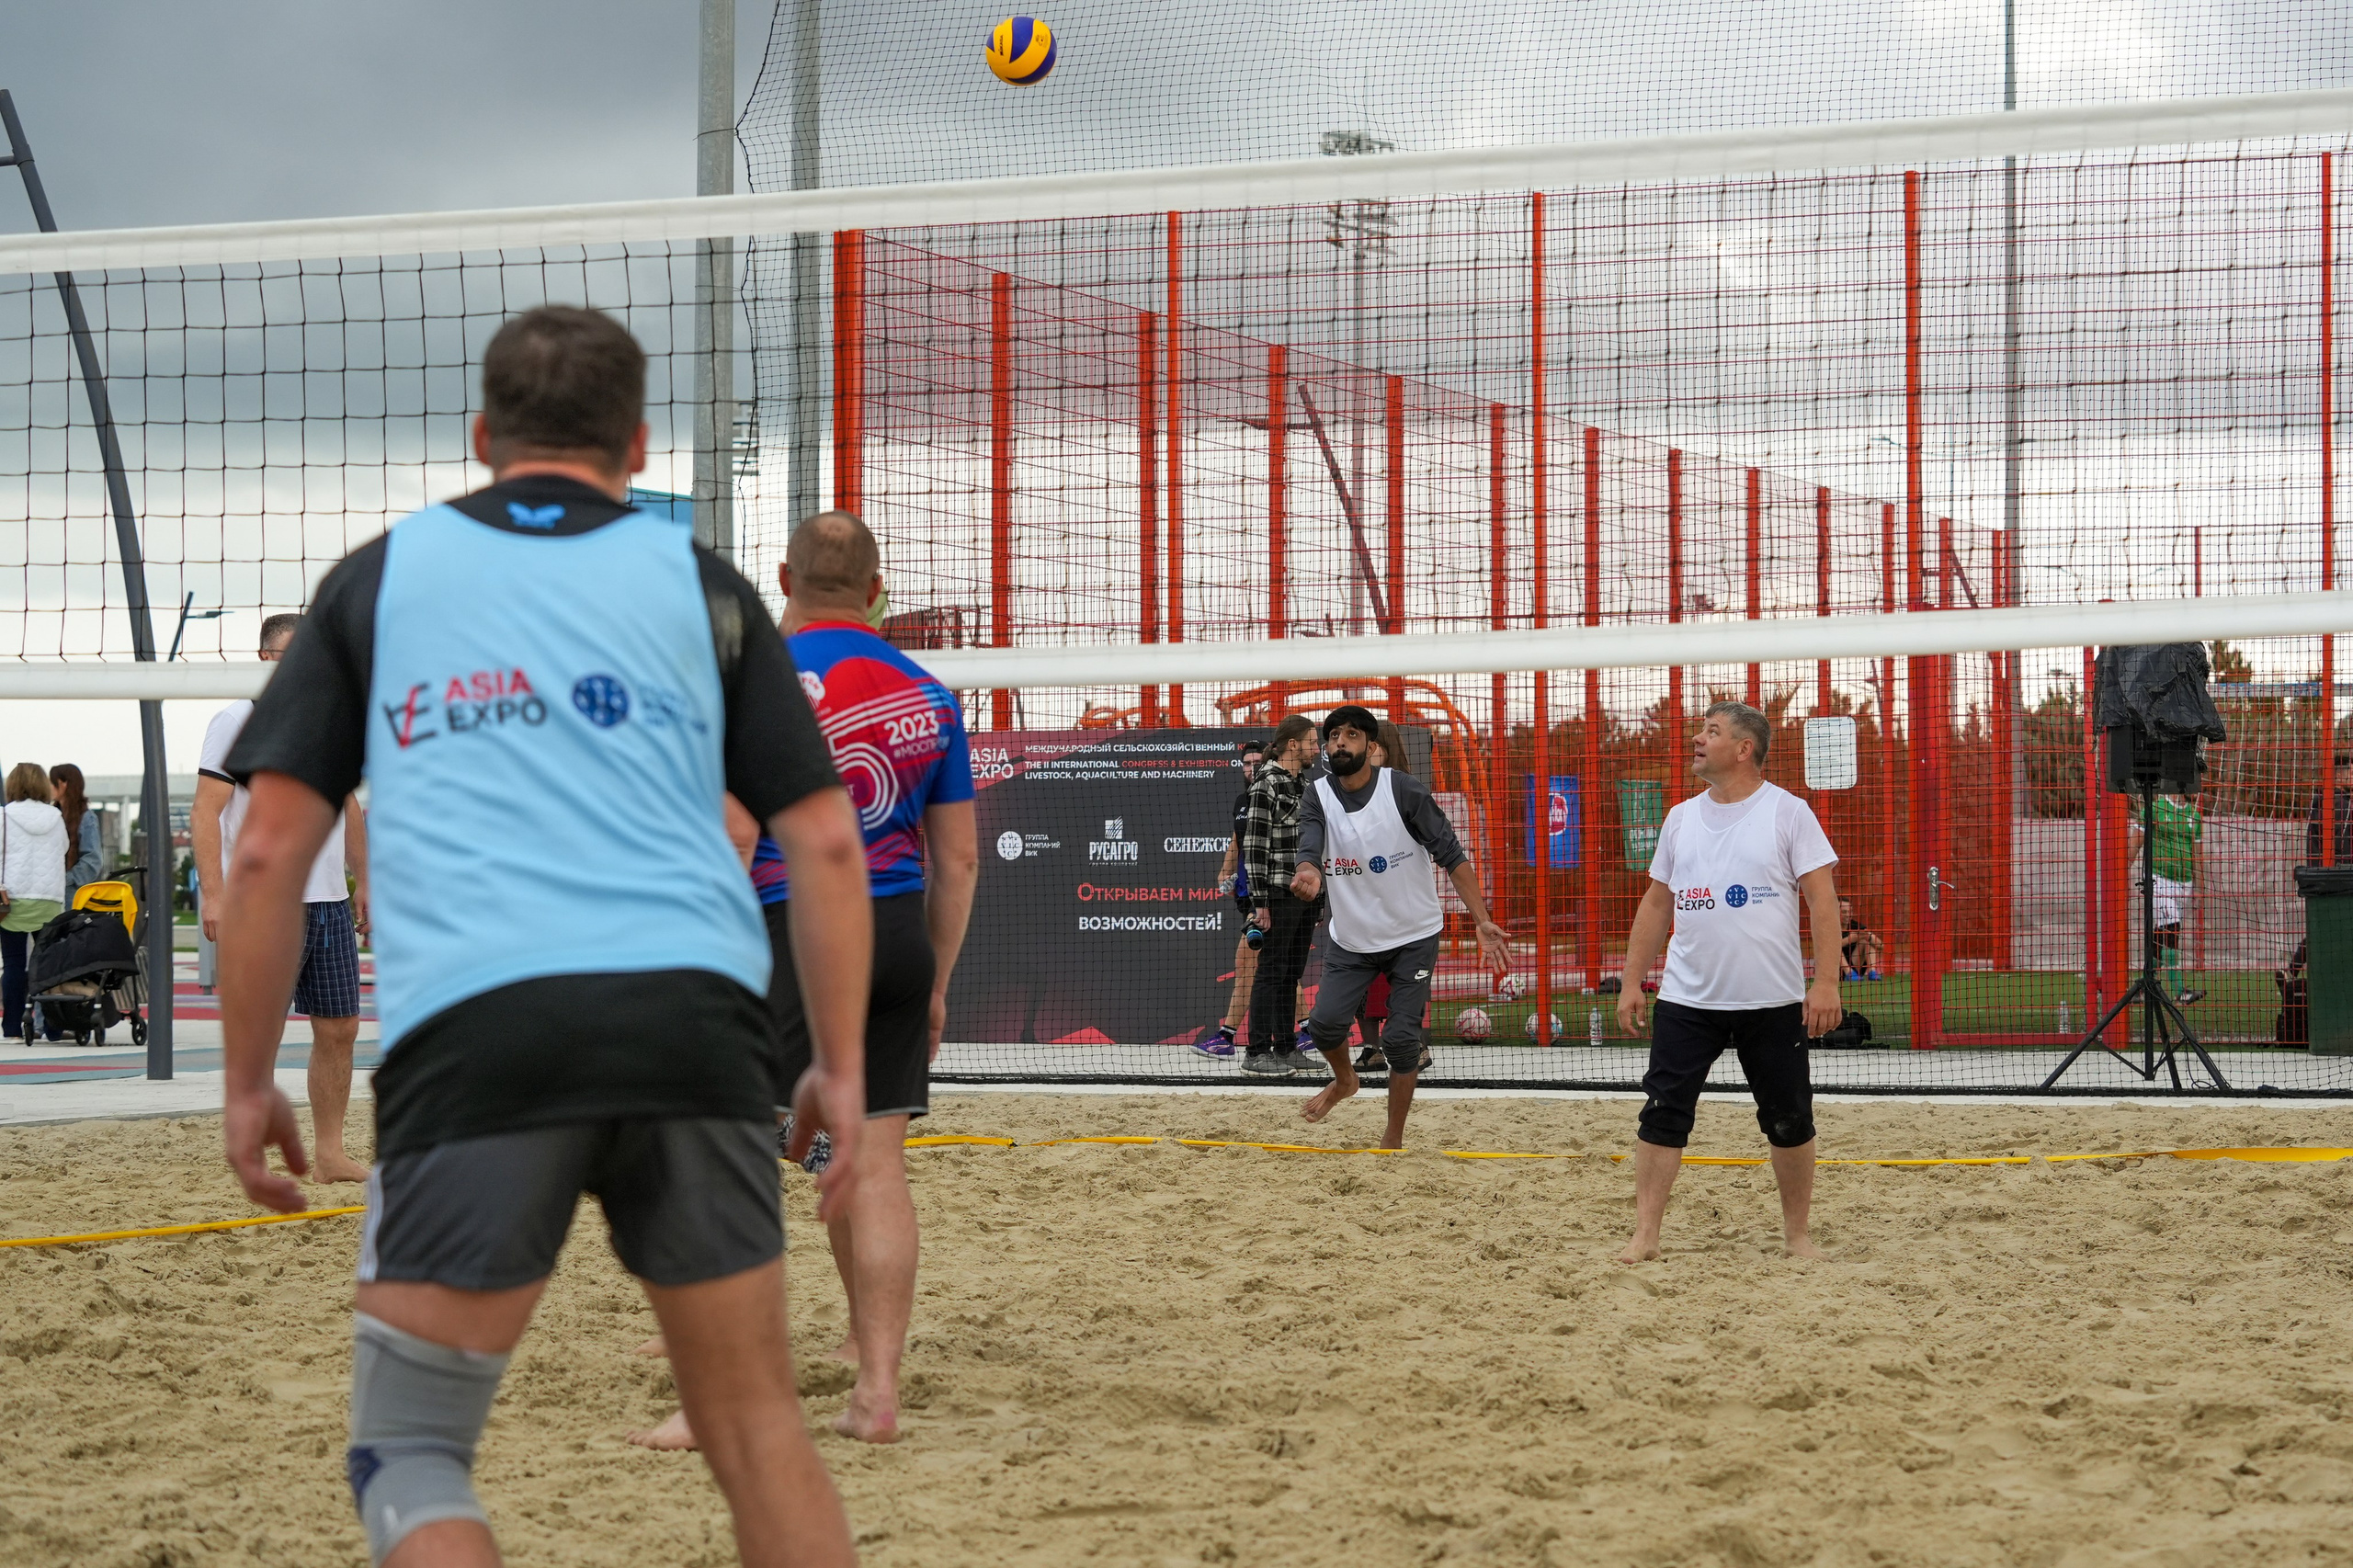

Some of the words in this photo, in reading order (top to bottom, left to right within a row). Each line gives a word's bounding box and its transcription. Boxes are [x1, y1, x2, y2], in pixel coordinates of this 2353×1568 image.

[444, 666, 533, 703] ASIA
[447, 696, 548, 733] EXPO
[883, 710, 940, 746] 2023
[1025, 743, 1111, 754] МЕЖДУНАРОДНЫЙ
[1113, 742, 1235, 753] СЕЛЬСКОХОЗЯЙСТВЕННЫЙ
[969, 747, 1009, 763] ASIA
[1025, 761, 1041, 769] THE
[1043, 761, 1050, 769] II
[1051, 760, 1120, 769] INTERNATIONAL
[1121, 760, 1168, 768] CONGRESS
[1178, 759, 1229, 768] EXHIBITION
[970, 763, 1014, 778] EXPO
[1025, 771, 1074, 780] LIVESTOCK,
[1074, 770, 1139, 780] AQUACULTURE
[1141, 770, 1161, 779] AND
[1162, 770, 1215, 779] MACHINERY
[1025, 841, 1061, 849] КОМПАНИЙ
[1089, 841, 1138, 861] РУСАГРО
[1335, 858, 1358, 868] ASIA
[1335, 867, 1363, 876] EXPO
[1686, 887, 1711, 899] ASIA
[1685, 898, 1715, 911] EXPO
